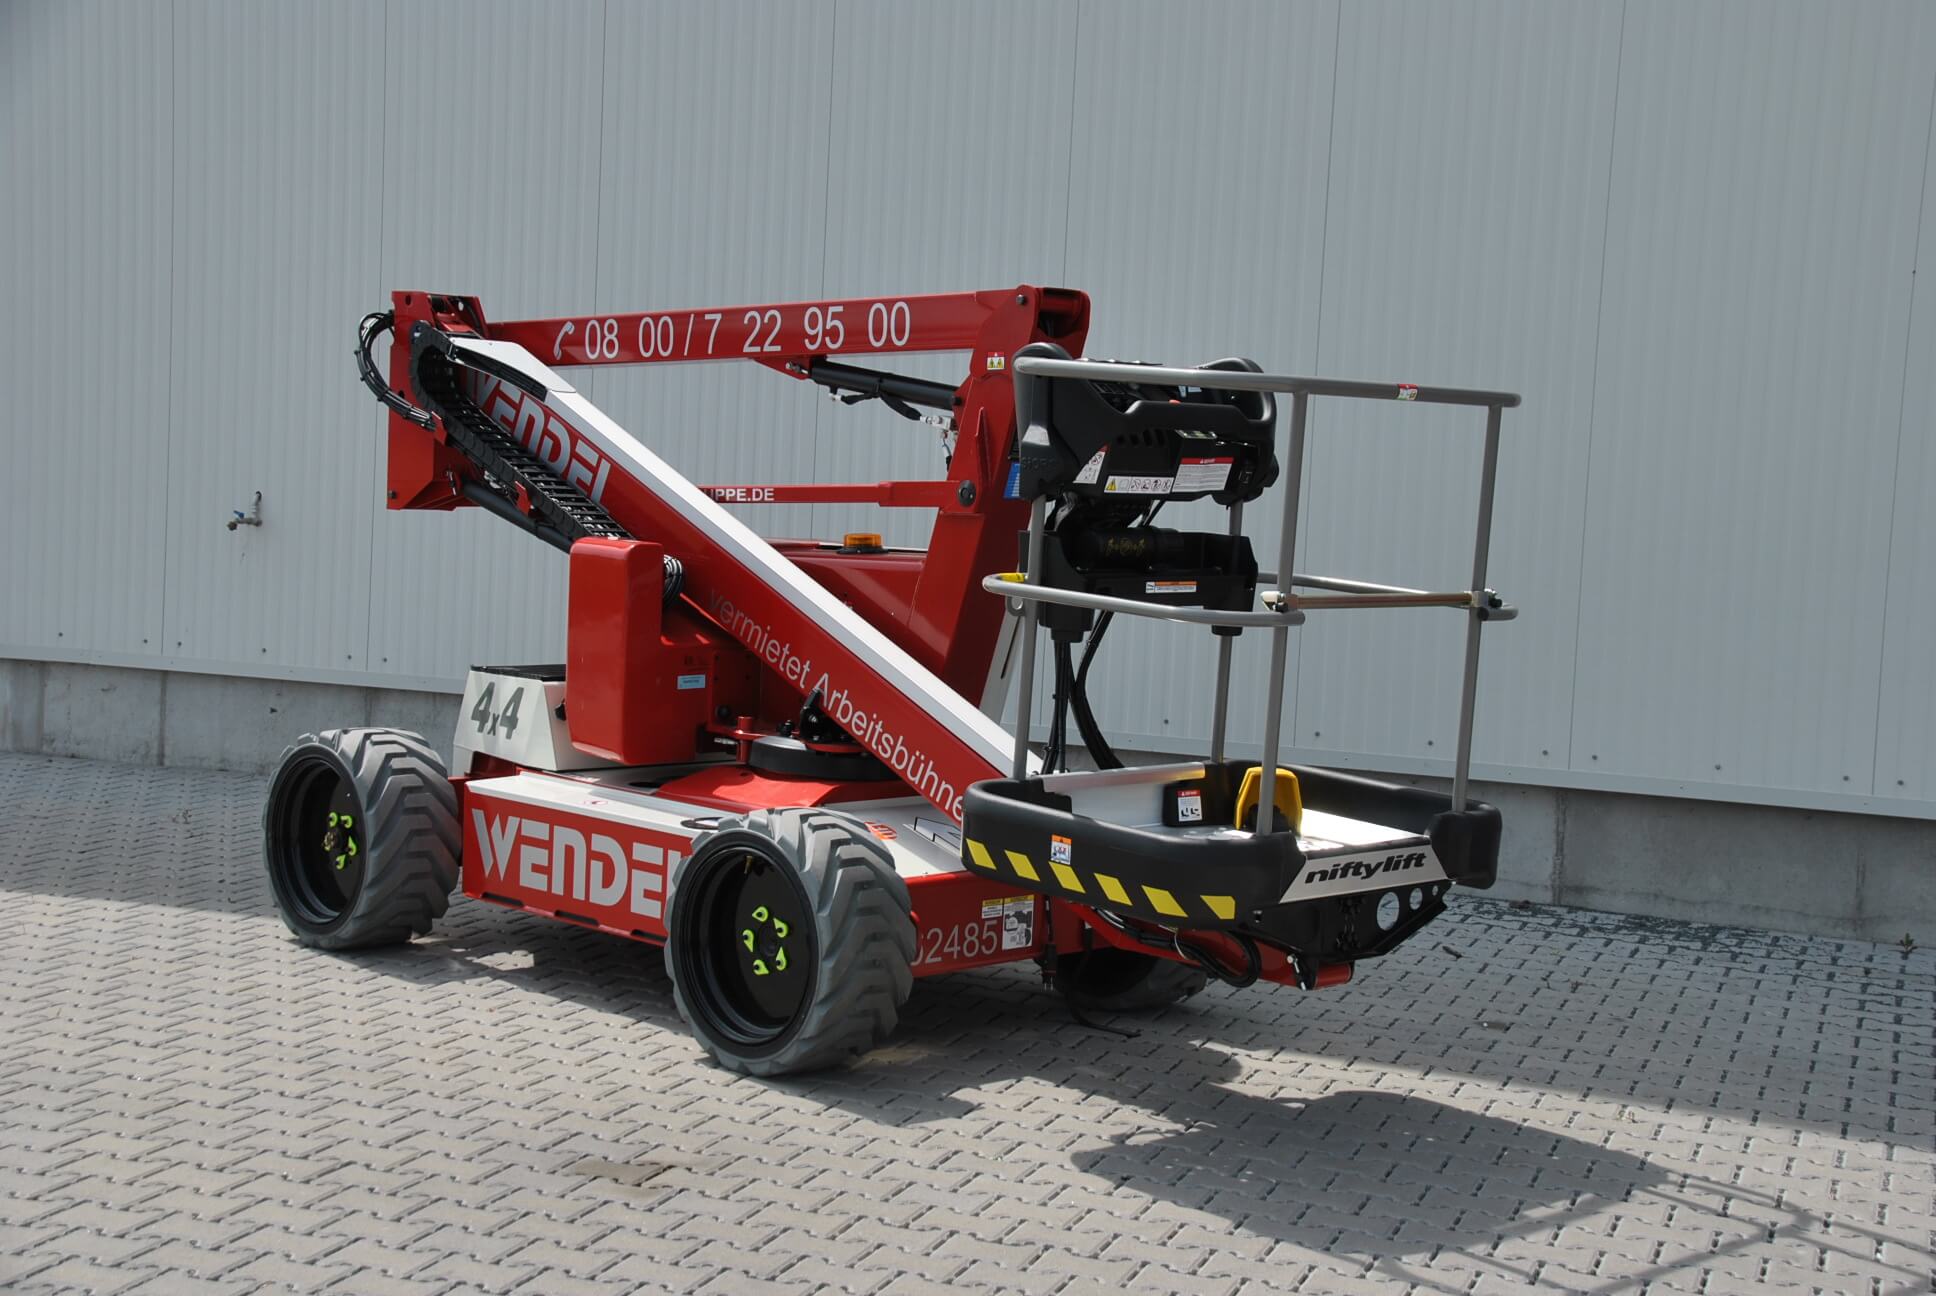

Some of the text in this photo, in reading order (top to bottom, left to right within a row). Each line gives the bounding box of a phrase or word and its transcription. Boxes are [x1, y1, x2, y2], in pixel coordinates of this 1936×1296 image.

[584, 319, 619, 360] 08
[742, 309, 782, 353] 22
[803, 305, 845, 351] 95
[868, 301, 910, 348] 00
[710, 588, 811, 690] vermietet
[471, 681, 525, 740] 4x4
[1305, 852, 1426, 884] niftylift
